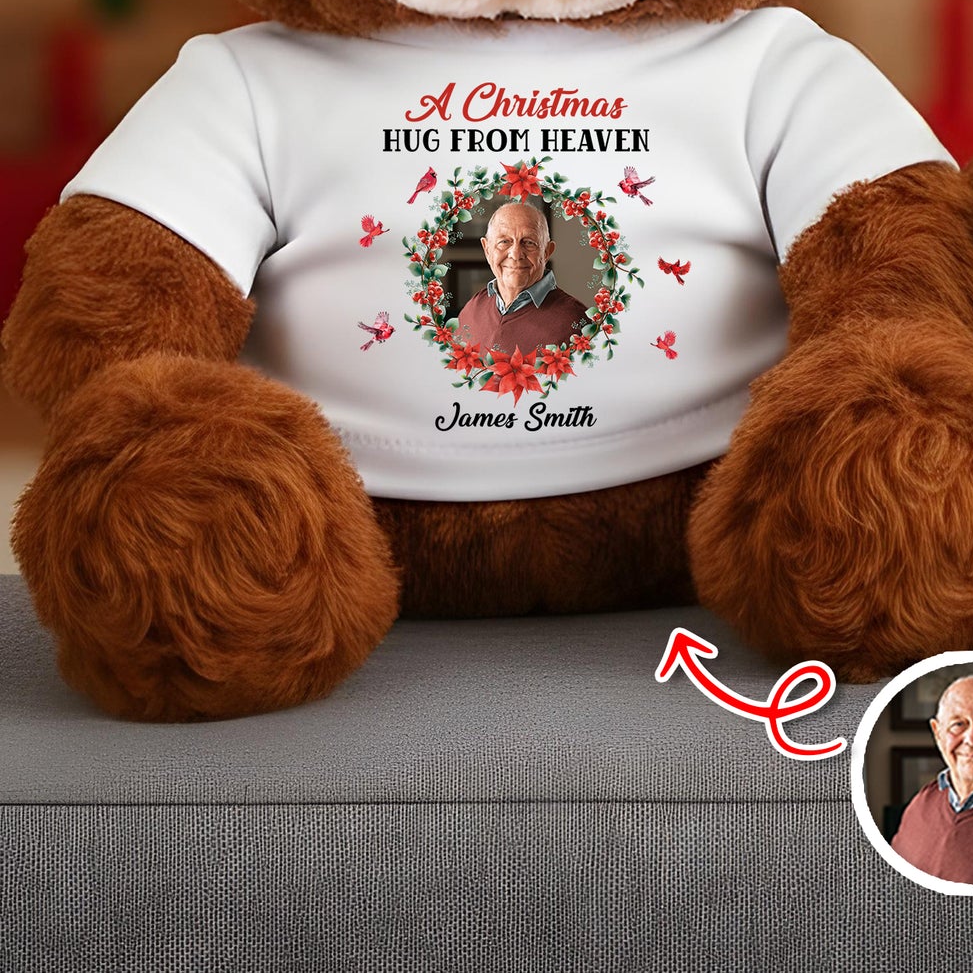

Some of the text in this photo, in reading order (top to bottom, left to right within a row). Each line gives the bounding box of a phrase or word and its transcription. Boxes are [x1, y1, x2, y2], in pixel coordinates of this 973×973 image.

[404, 81, 629, 123] A Christmas
[382, 128, 650, 153] HUG FROM HEAVEN
[434, 401, 598, 432] James Smith
